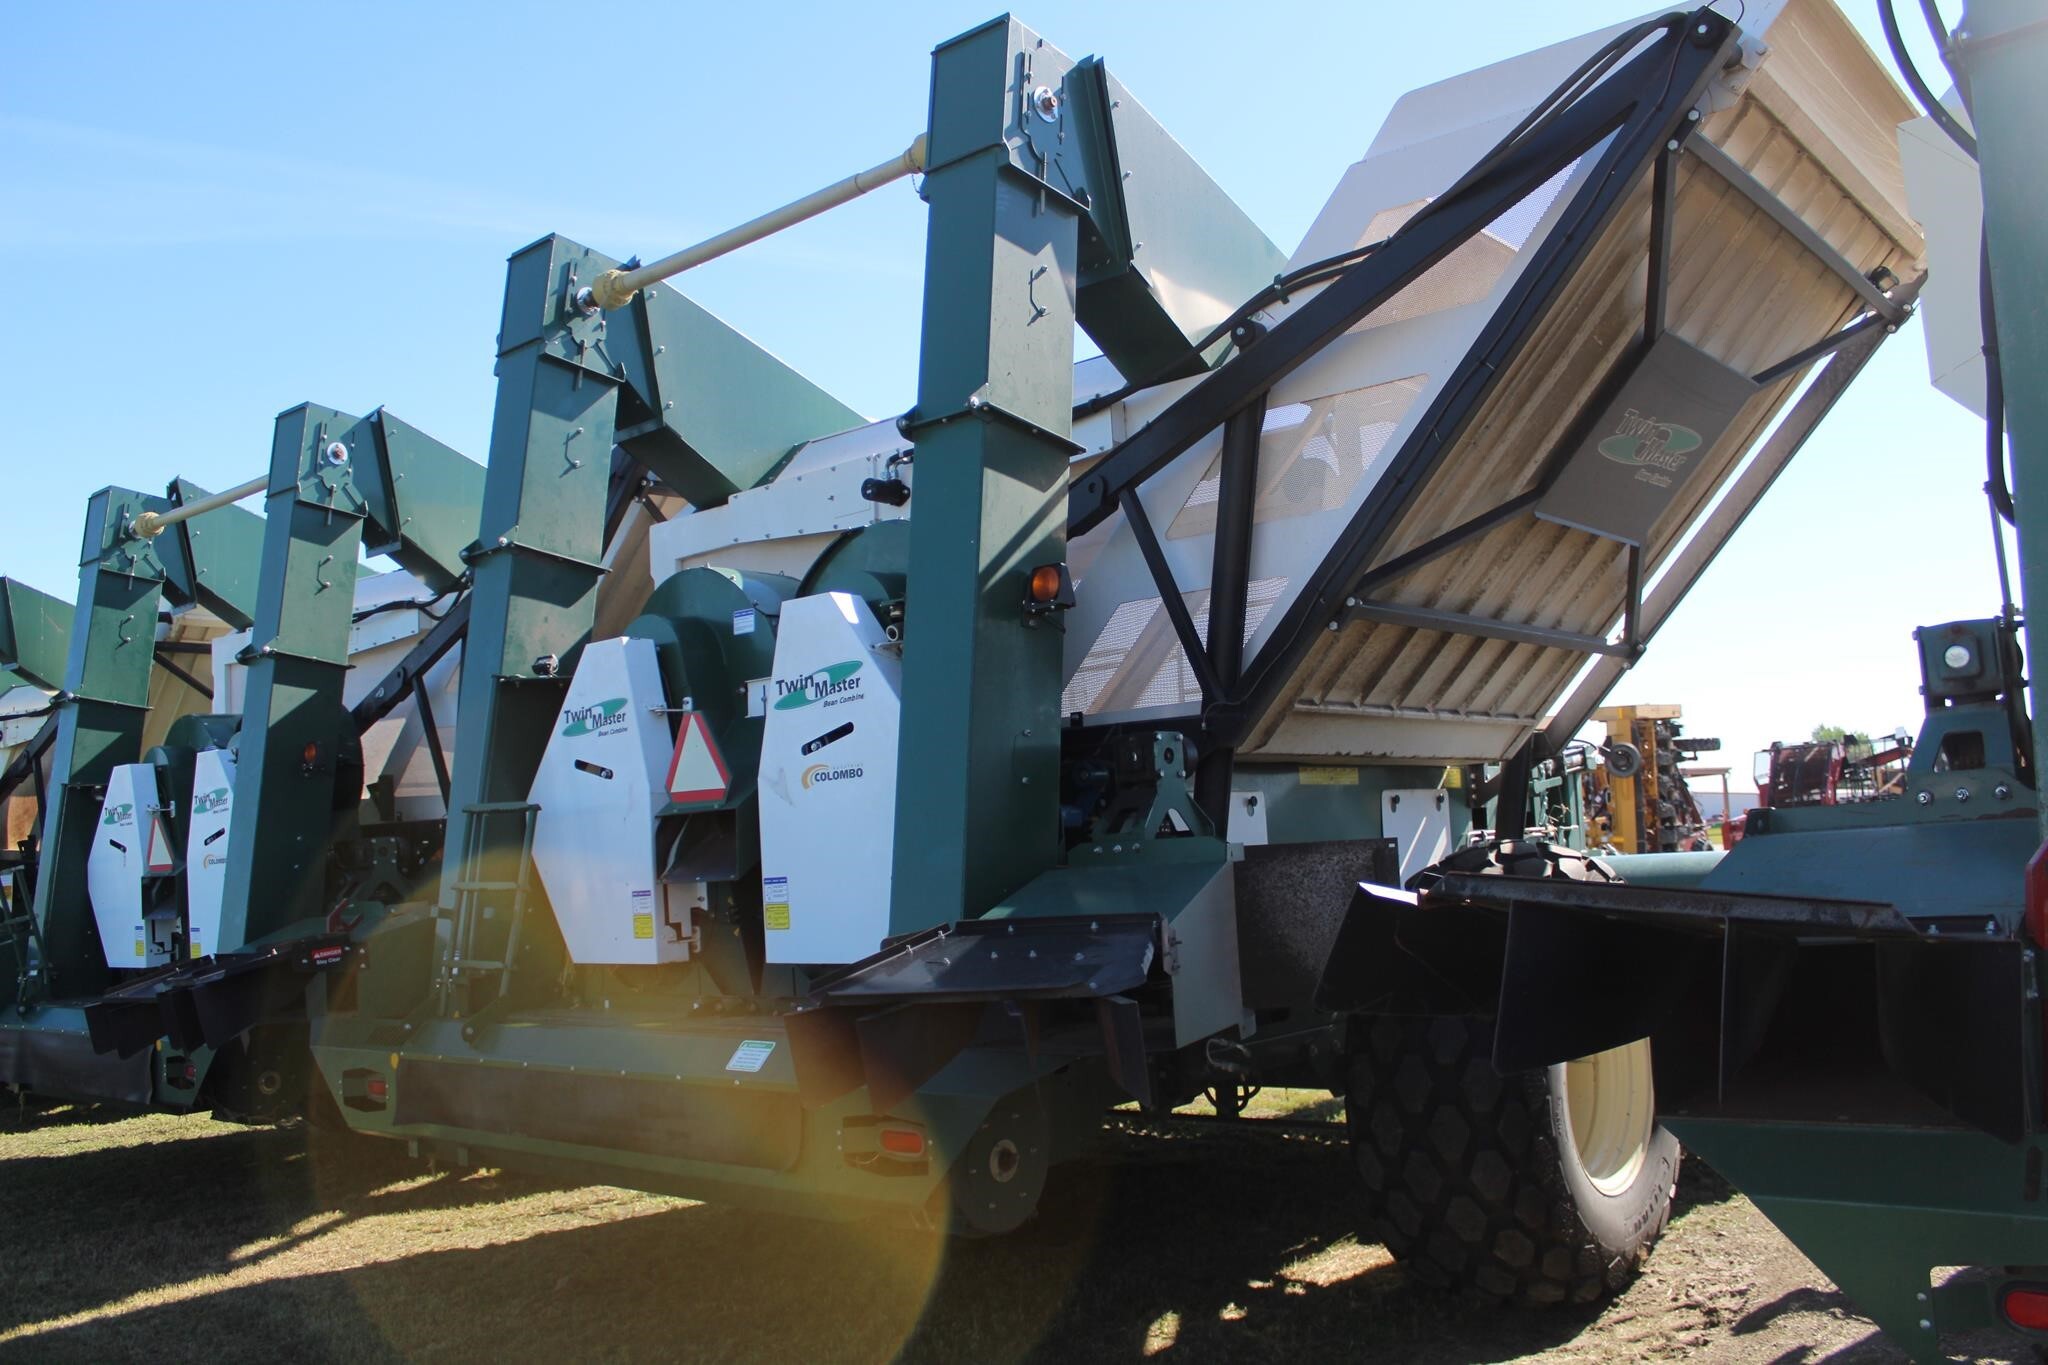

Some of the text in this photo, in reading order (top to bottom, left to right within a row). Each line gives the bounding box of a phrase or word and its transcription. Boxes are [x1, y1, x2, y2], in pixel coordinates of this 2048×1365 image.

[776, 675, 814, 696] Twin
[814, 677, 861, 699] Master
[823, 693, 865, 708] Bean Combine
[564, 707, 592, 724] Twin
[592, 712, 626, 729] Master
[814, 768, 864, 782] COLOMBO
[194, 793, 210, 805] Twin
[209, 798, 228, 809] Master
[105, 807, 118, 817] Twin
